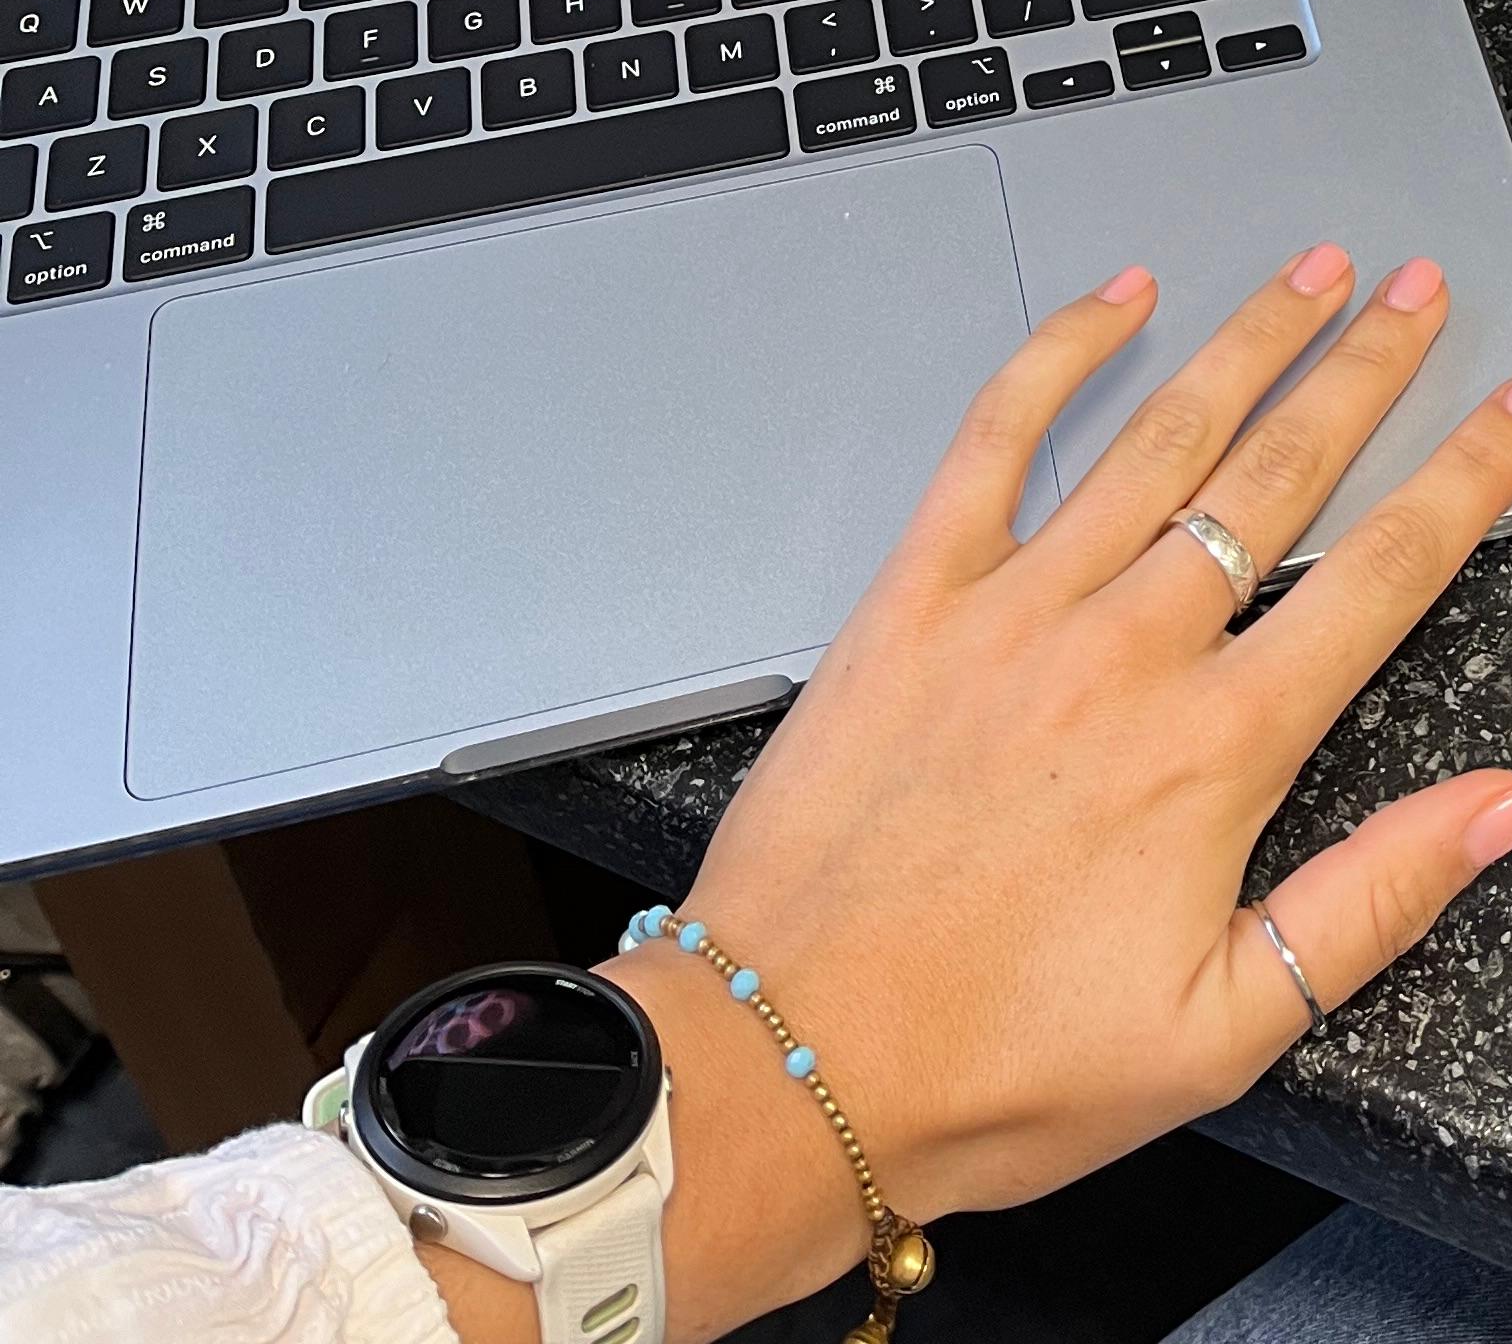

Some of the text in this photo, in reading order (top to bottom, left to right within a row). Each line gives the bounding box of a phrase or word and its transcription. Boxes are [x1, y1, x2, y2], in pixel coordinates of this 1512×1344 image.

[20, 14, 39, 32] Q
[465, 12, 482, 30] G
[364, 29, 378, 48] F
[256, 49, 274, 67] D
[149, 67, 166, 86] S
[39, 87, 58, 105] A
[946, 92, 999, 110] option
[816, 108, 899, 134] command
[141, 234, 234, 263] command
[25, 264, 87, 285] option
